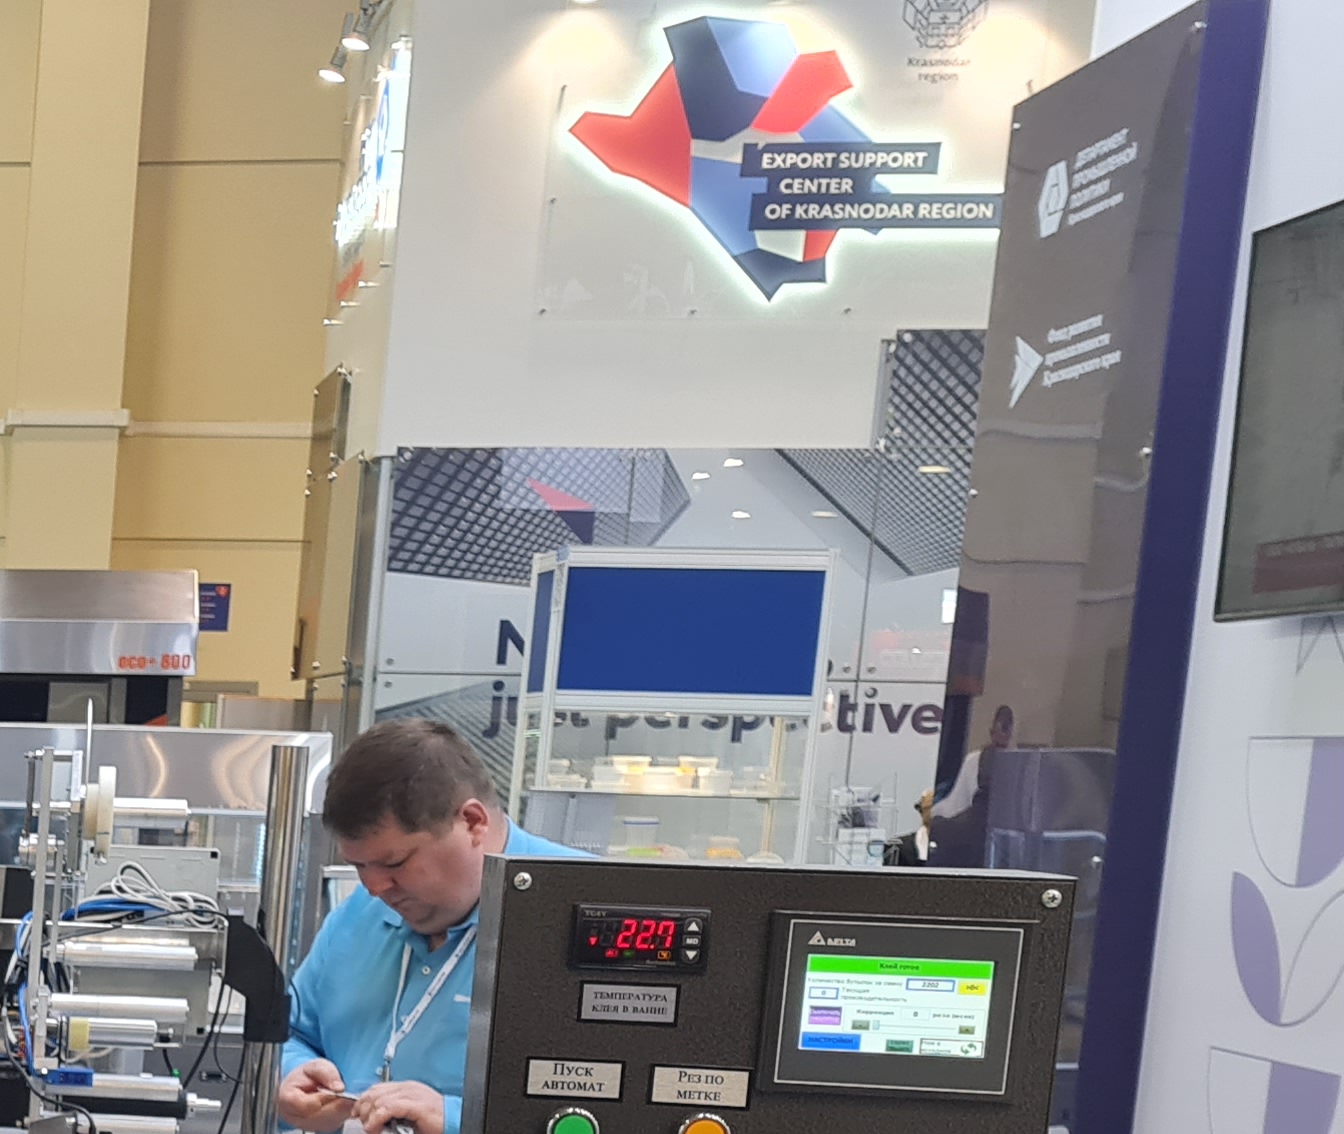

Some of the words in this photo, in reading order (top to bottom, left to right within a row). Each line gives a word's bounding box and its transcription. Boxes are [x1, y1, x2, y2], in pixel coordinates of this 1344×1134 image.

[762, 152, 836, 169] EXPORT
[838, 152, 928, 168] SUPPORT
[779, 177, 853, 194] CENTER
[764, 203, 792, 220] OF
[795, 203, 914, 219] KRASNODAR
[918, 203, 994, 219] REGION
[593, 991, 668, 1002] ТЕМПЕРАТУРА
[592, 1004, 619, 1013] КЛЕЯ
[632, 1005, 667, 1015] ВАННЕ
[541, 1081, 605, 1092] АВТОМАТ
[676, 1090, 721, 1101] МЕТКЕ
